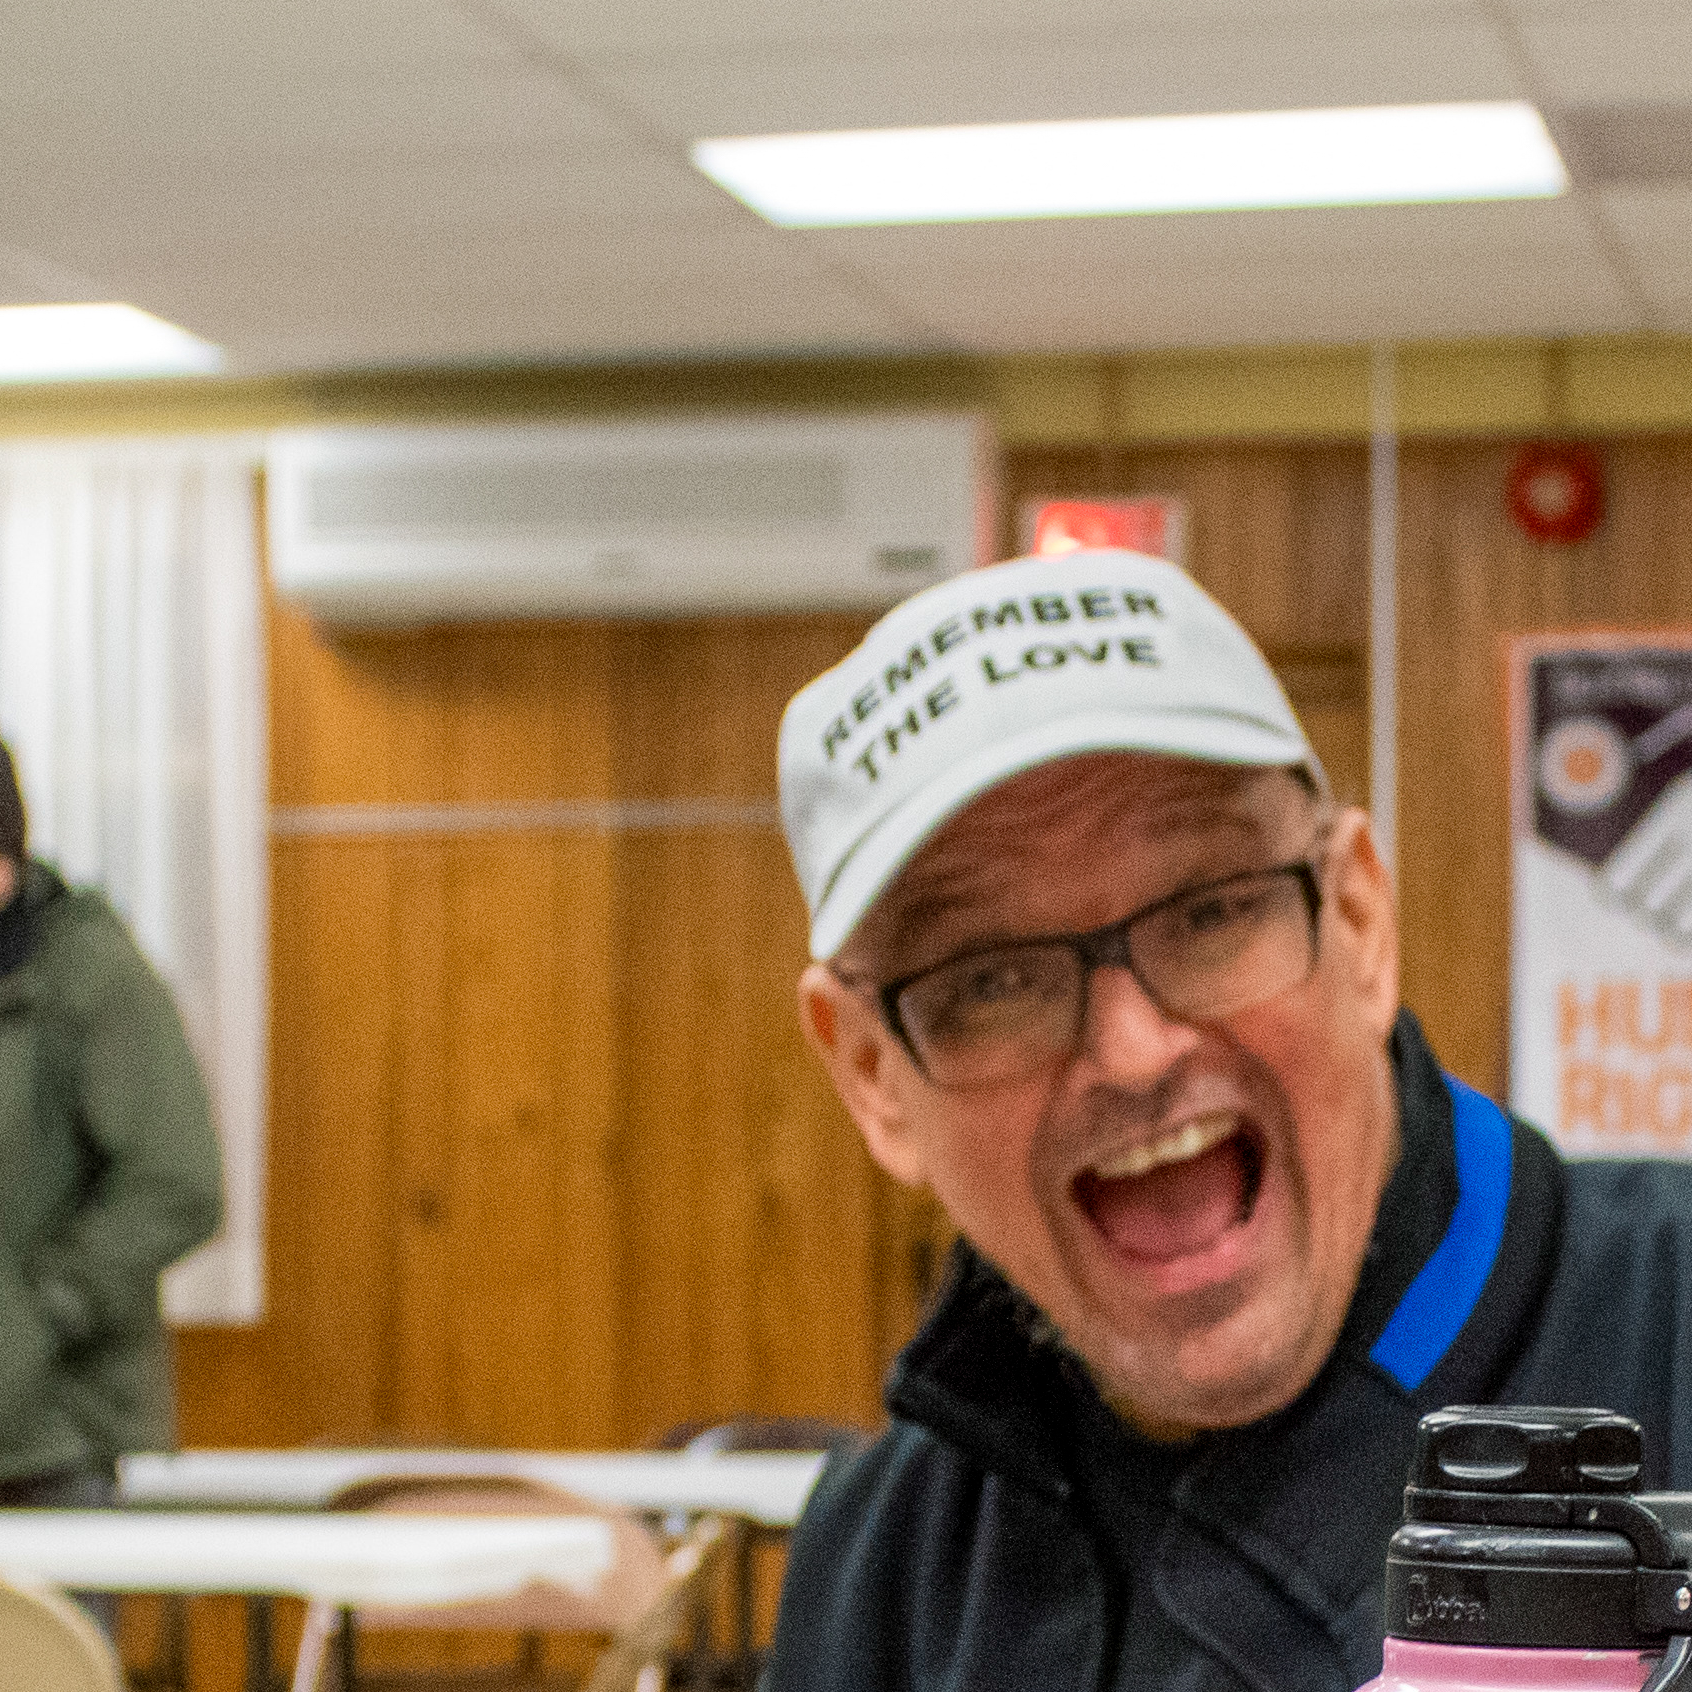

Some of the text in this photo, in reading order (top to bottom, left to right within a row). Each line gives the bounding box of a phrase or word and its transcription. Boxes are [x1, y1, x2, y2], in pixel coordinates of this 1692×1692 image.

[821, 586, 1166, 760] REMEMBER
[850, 634, 1163, 783] THE LOVE
